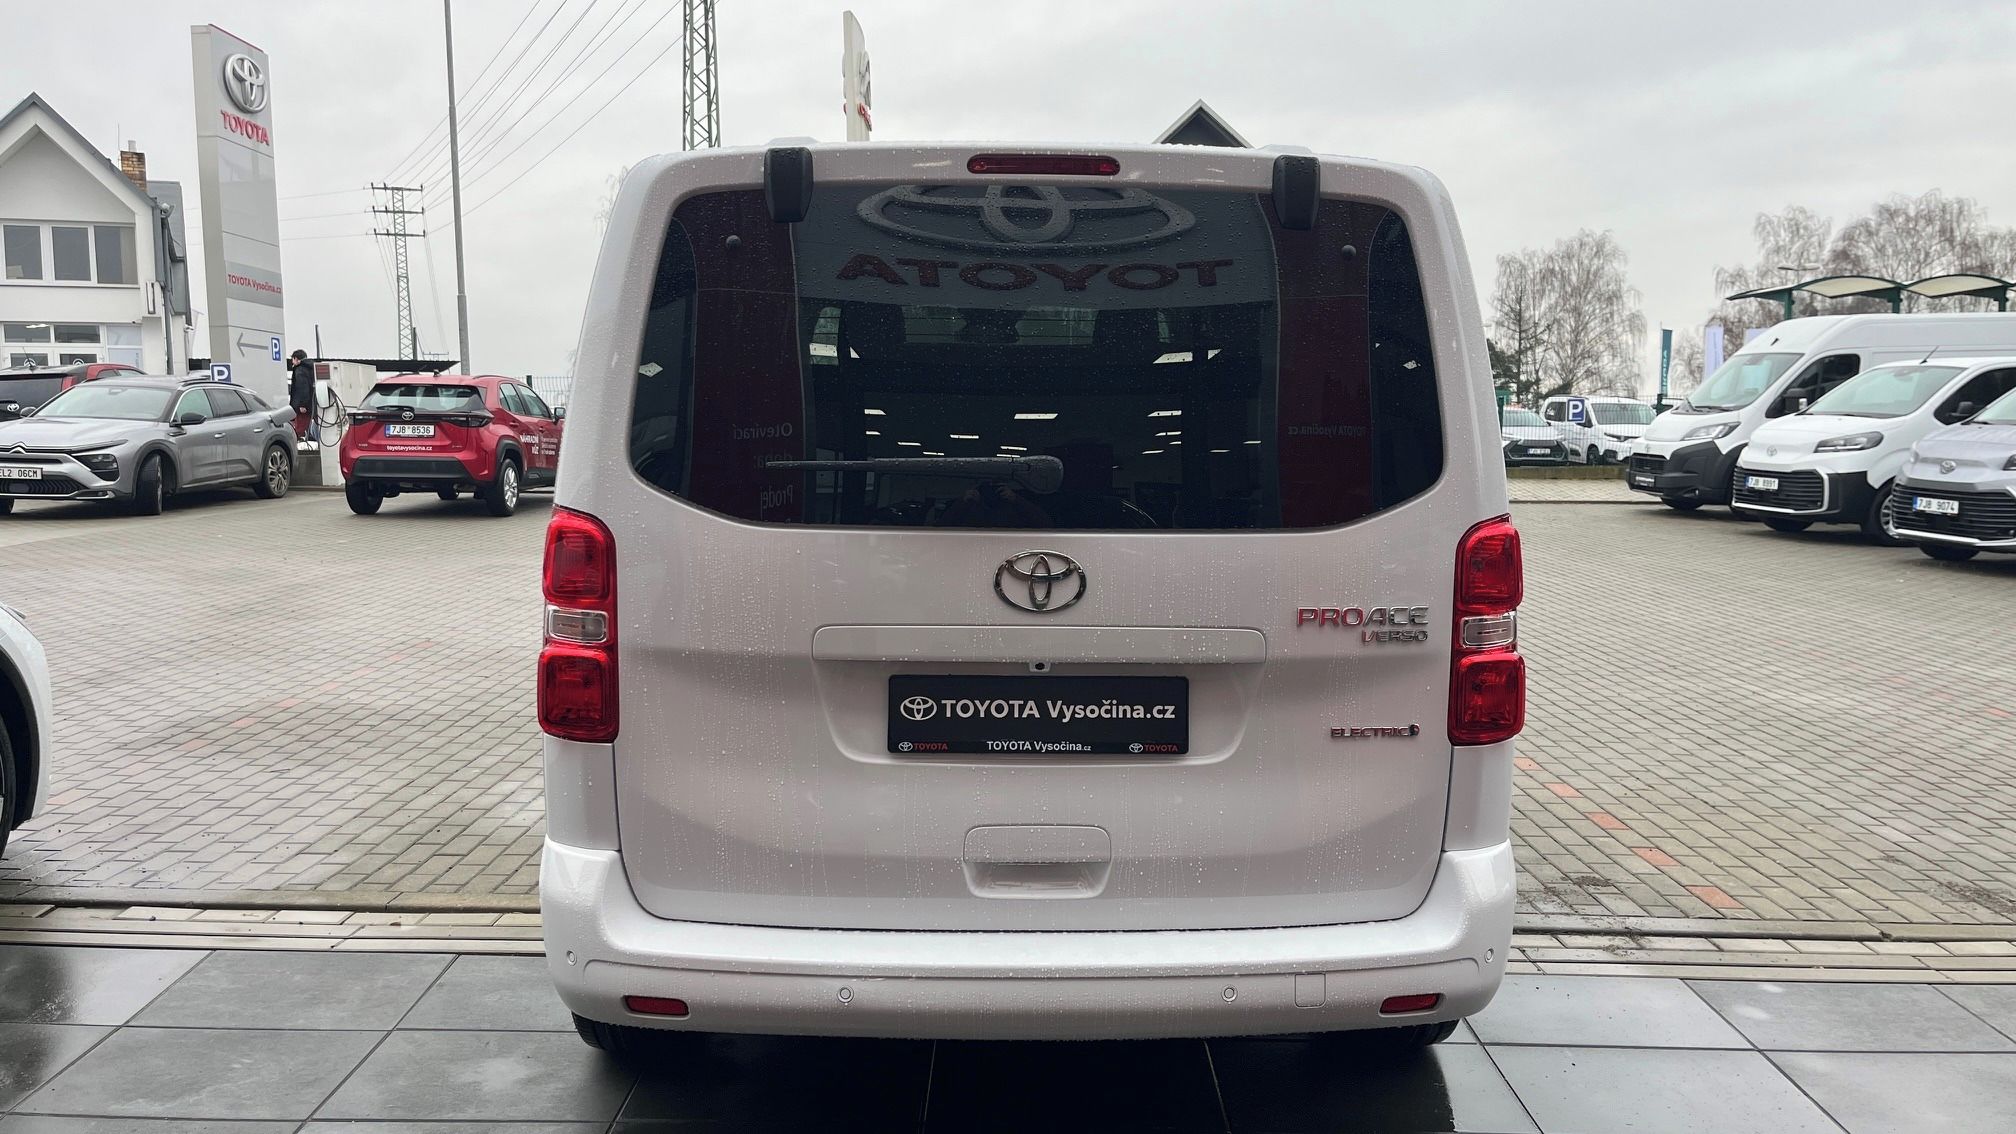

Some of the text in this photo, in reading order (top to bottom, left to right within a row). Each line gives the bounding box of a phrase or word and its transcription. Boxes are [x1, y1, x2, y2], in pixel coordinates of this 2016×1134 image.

[221, 109, 269, 146] TOYOTA
[228, 274, 252, 287] TOYOTA
[213, 366, 229, 381] P
[1568, 400, 1583, 420] P
[411, 425, 431, 434] 8536
[18, 469, 38, 478] 06CM
[1936, 501, 1955, 511] 9074
[1297, 606, 1429, 626] PROACE
[1361, 629, 1428, 643] VERSO
[941, 699, 1175, 723] TOYOTA Vysočina.cz
[1331, 727, 1409, 738] ELECTRIC
[913, 742, 948, 751] TOYOTA
[987, 741, 1092, 753] TOYOTA Vysočina.cz
[1145, 743, 1178, 752] TOYOTA
